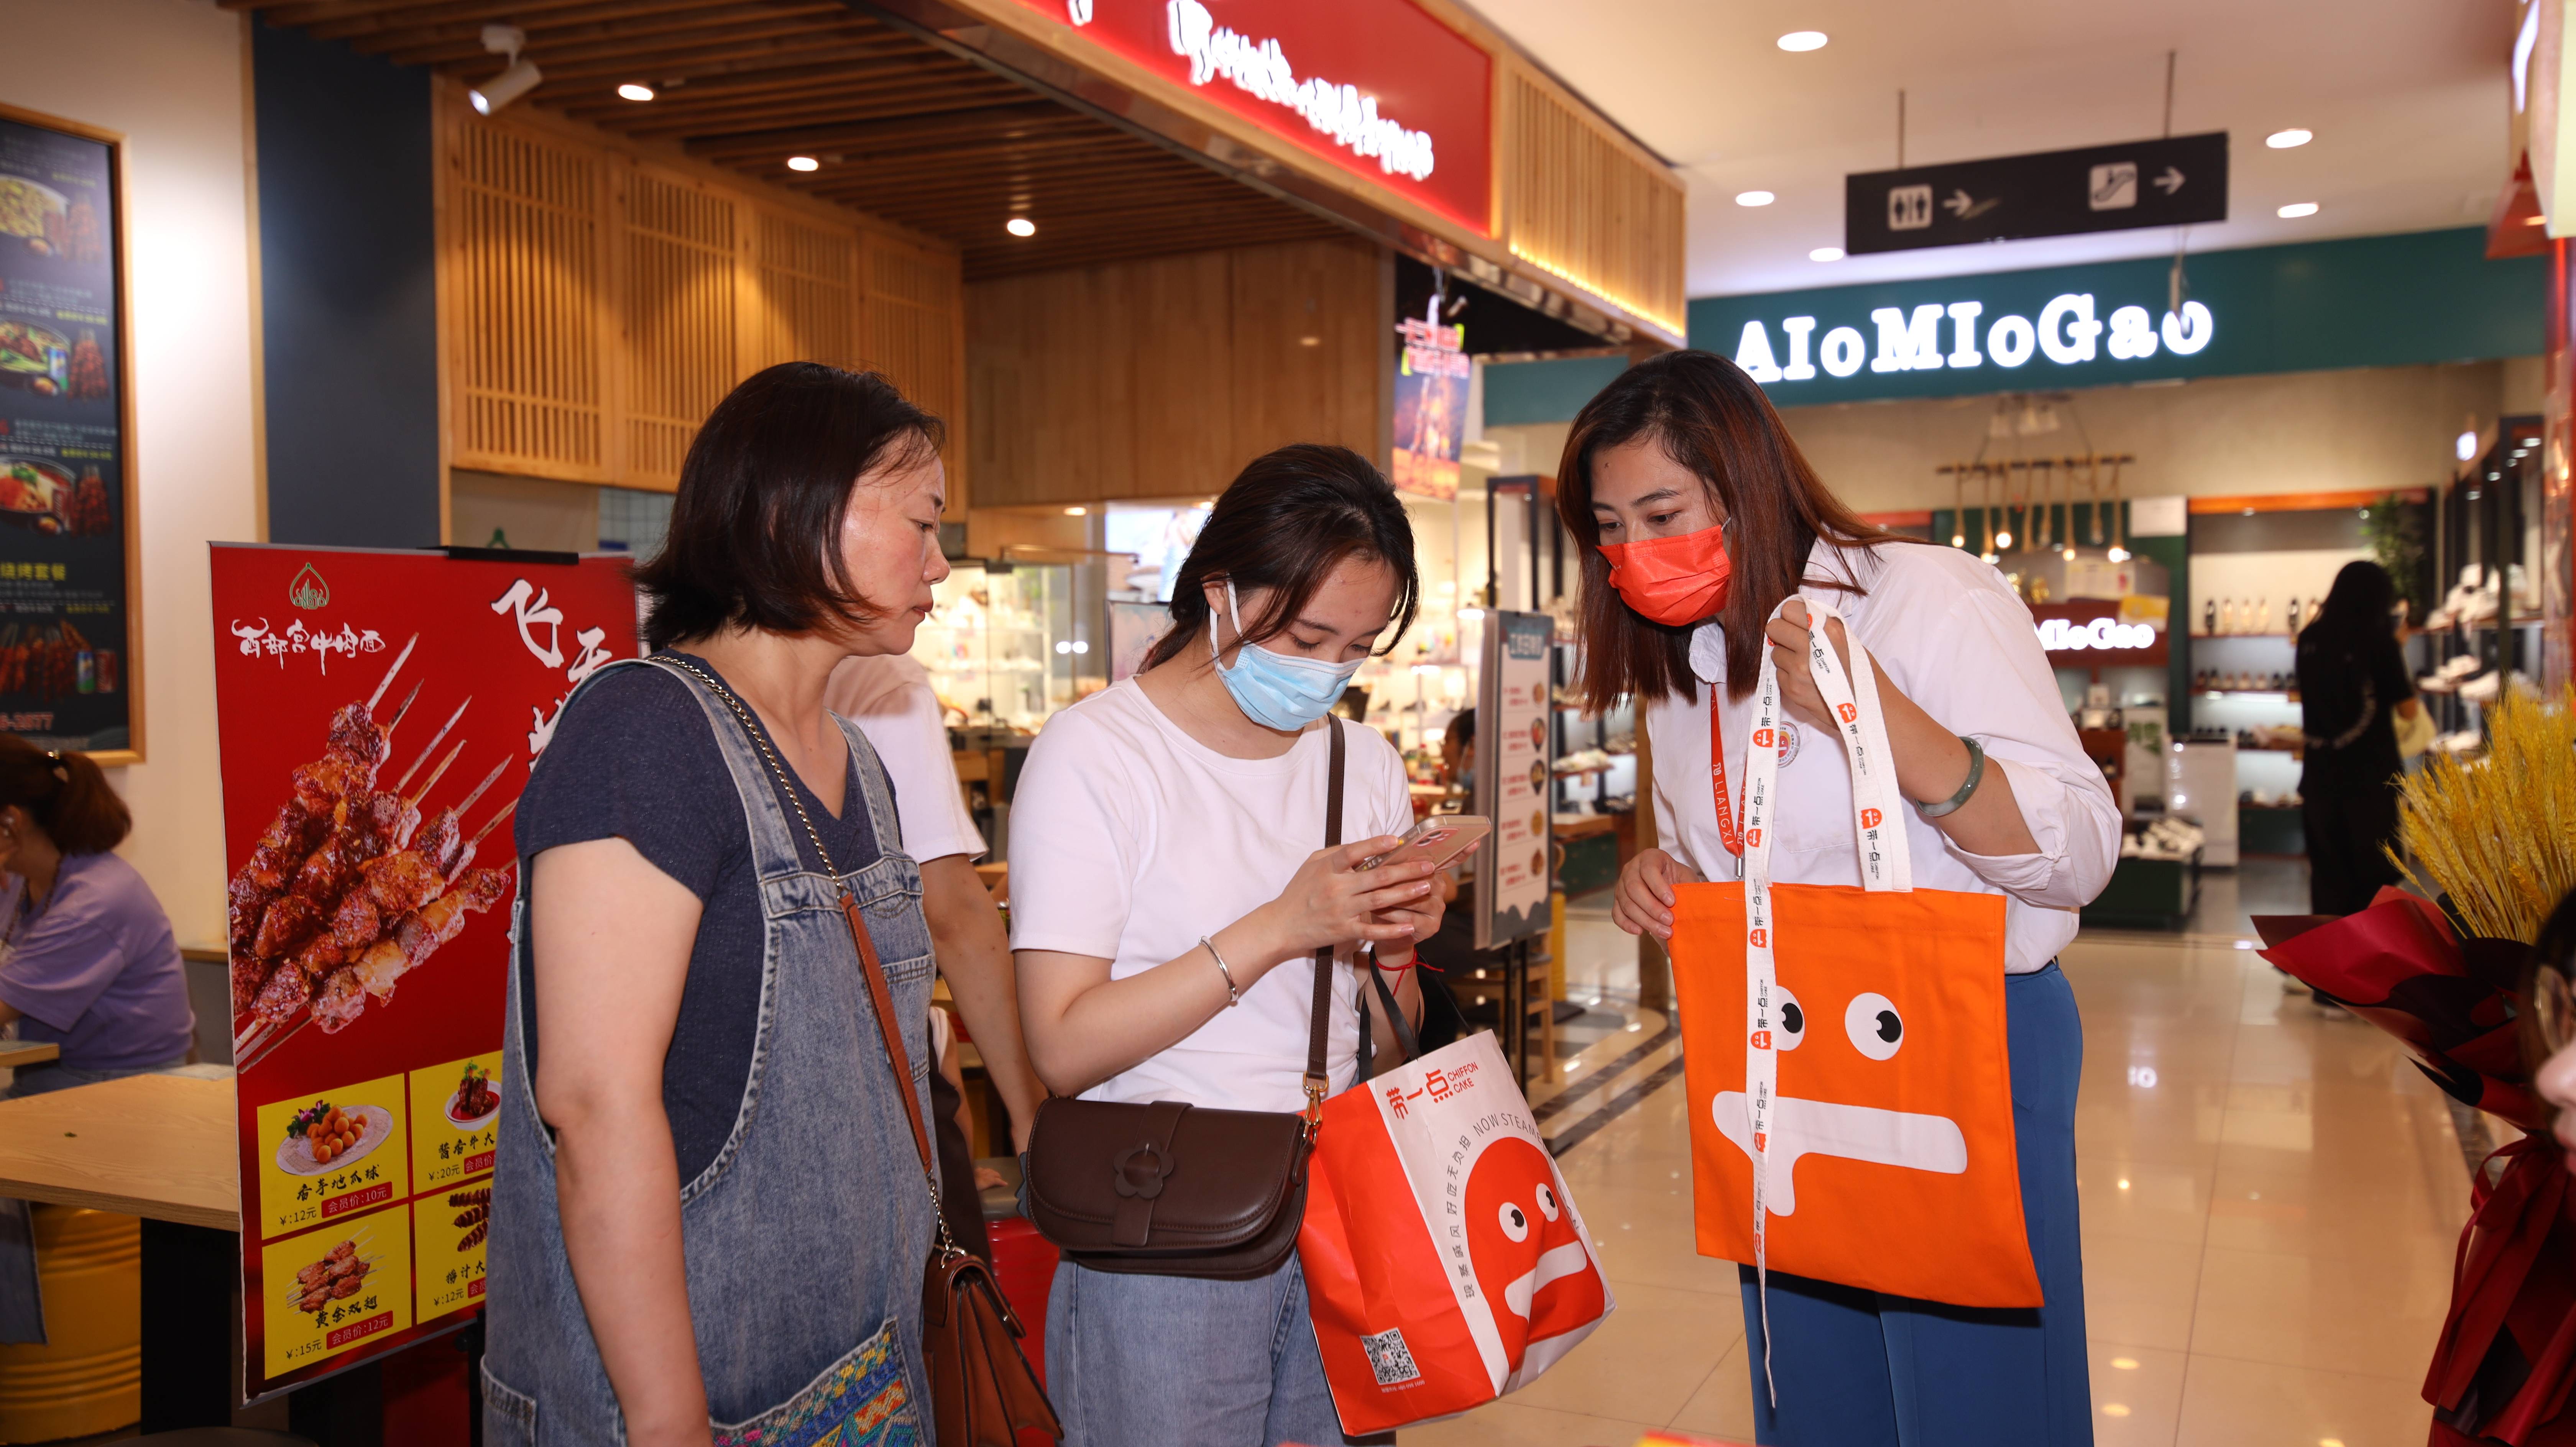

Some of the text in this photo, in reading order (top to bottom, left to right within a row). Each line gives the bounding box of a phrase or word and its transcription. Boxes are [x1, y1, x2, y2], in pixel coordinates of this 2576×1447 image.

[1715, 781, 1734, 845] LIANGXI
[1447, 1061, 1479, 1081] CHIFFON
[1453, 1078, 1474, 1093] CAKE
[1473, 1113, 1499, 1137] NOW
[328, 1187, 387, 1214] 会员价:10元
[332, 1316, 388, 1345] 会员价:12元
